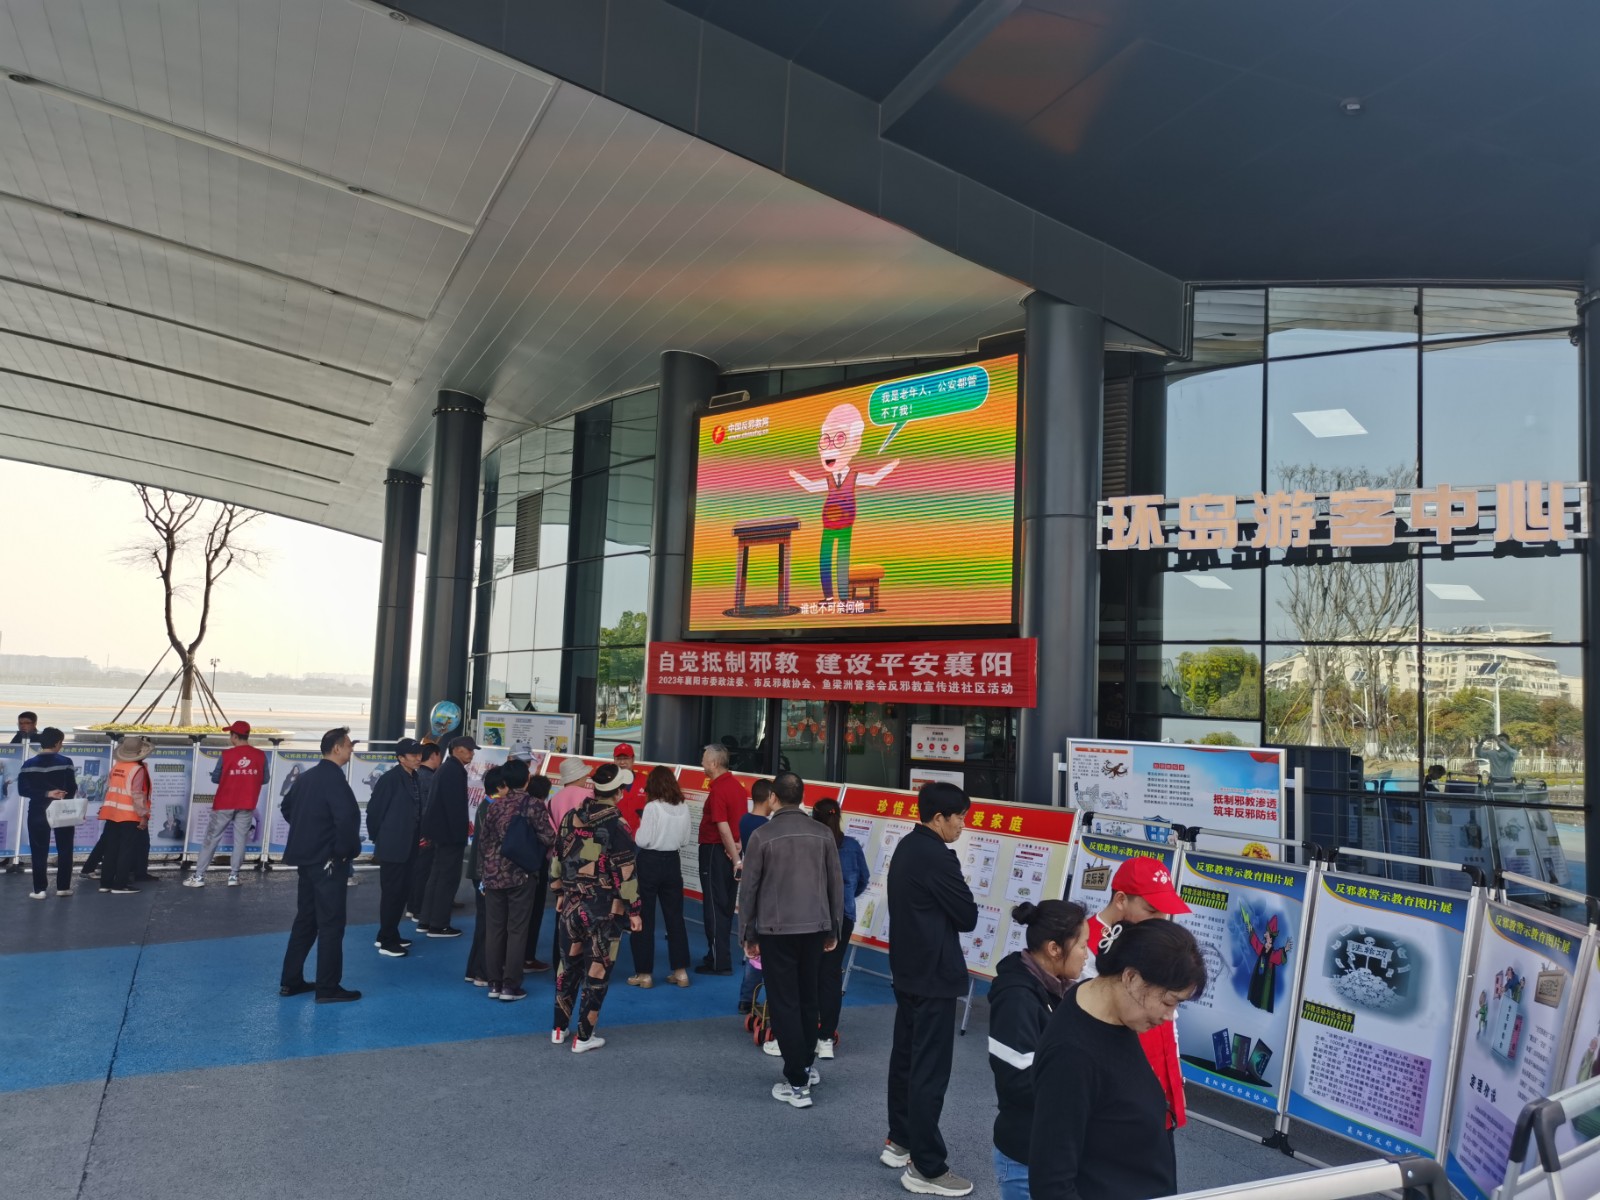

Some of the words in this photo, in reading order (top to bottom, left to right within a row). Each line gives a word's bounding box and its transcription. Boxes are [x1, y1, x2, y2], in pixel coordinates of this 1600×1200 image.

[1107, 480, 1568, 551] 环岛游客中心
[800, 600, 865, 614] 谁也不可奈何他
[659, 650, 799, 675] 自觉抵制邪教
[815, 651, 1013, 678] 建设平安襄阳
[1213, 793, 1278, 809] 抵制邪教渗透
[1213, 805, 1278, 821] 筑牢反邪防线
[971, 811, 1025, 832] 爱家庭
[1196, 862, 1295, 887] 反邪教警示教育图片展
[1335, 883, 1453, 914] 反邪教警示教育图片展
[1496, 915, 1571, 954] 反邪教警示教育图片展
